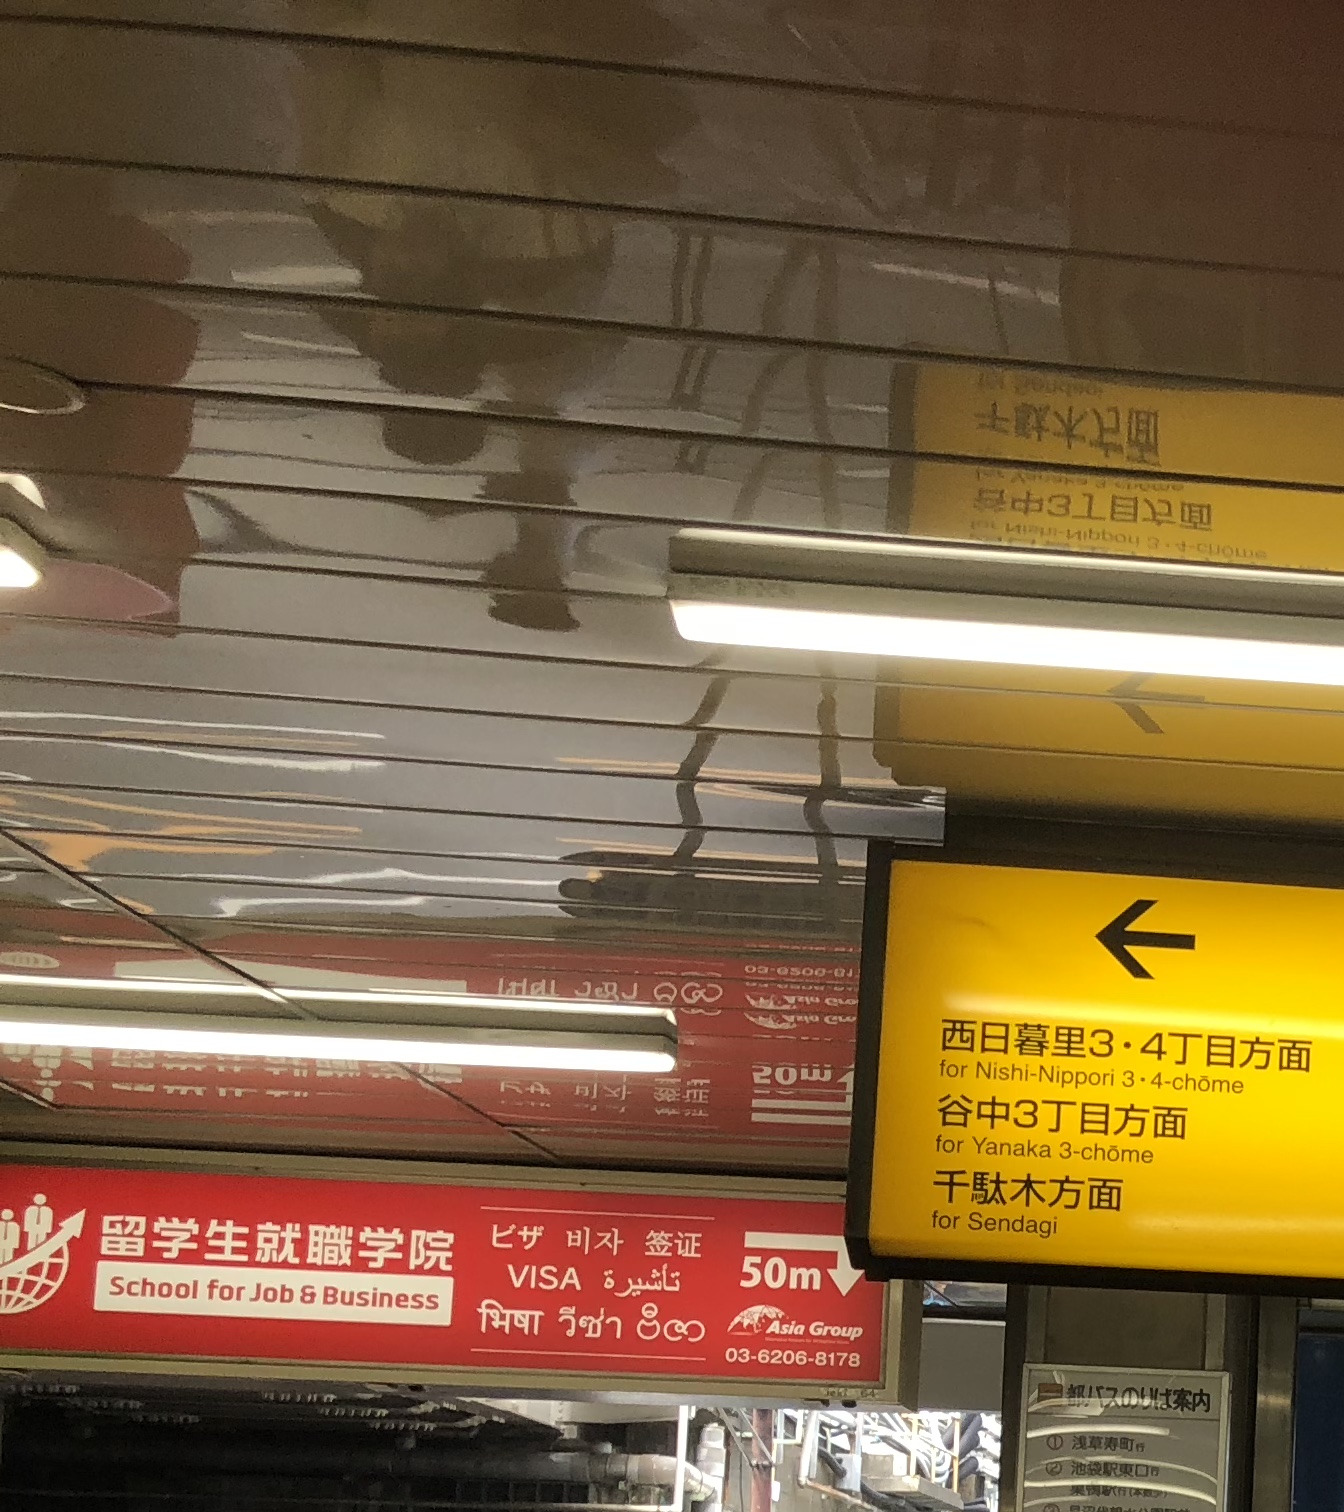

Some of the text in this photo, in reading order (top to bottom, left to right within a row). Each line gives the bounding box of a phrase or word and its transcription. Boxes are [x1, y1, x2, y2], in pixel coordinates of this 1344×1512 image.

[940, 1018, 1313, 1073] 西日暮里3・4丁目方面
[939, 1058, 969, 1080] for
[975, 1060, 1116, 1090] Nishi-Nippori
[936, 1093, 1189, 1141] 谷中3丁目方面
[935, 1133, 966, 1155] for
[972, 1135, 1053, 1158] Yanaka
[932, 1168, 1124, 1213] 千駄木方面
[491, 1222, 545, 1251] ビザ
[931, 1211, 1058, 1239] for Sendagi
[100, 1214, 455, 1271] 留学生就職学院
[566, 1226, 624, 1257] 비자
[644, 1230, 702, 1259] 签证
[507, 1264, 582, 1291] VISA
[738, 1255, 822, 1291] 50m
[108, 1275, 440, 1311] School for Job & Business
[766, 1320, 863, 1340] Asia Group
[725, 1347, 861, 1368] 03-6206-8178
